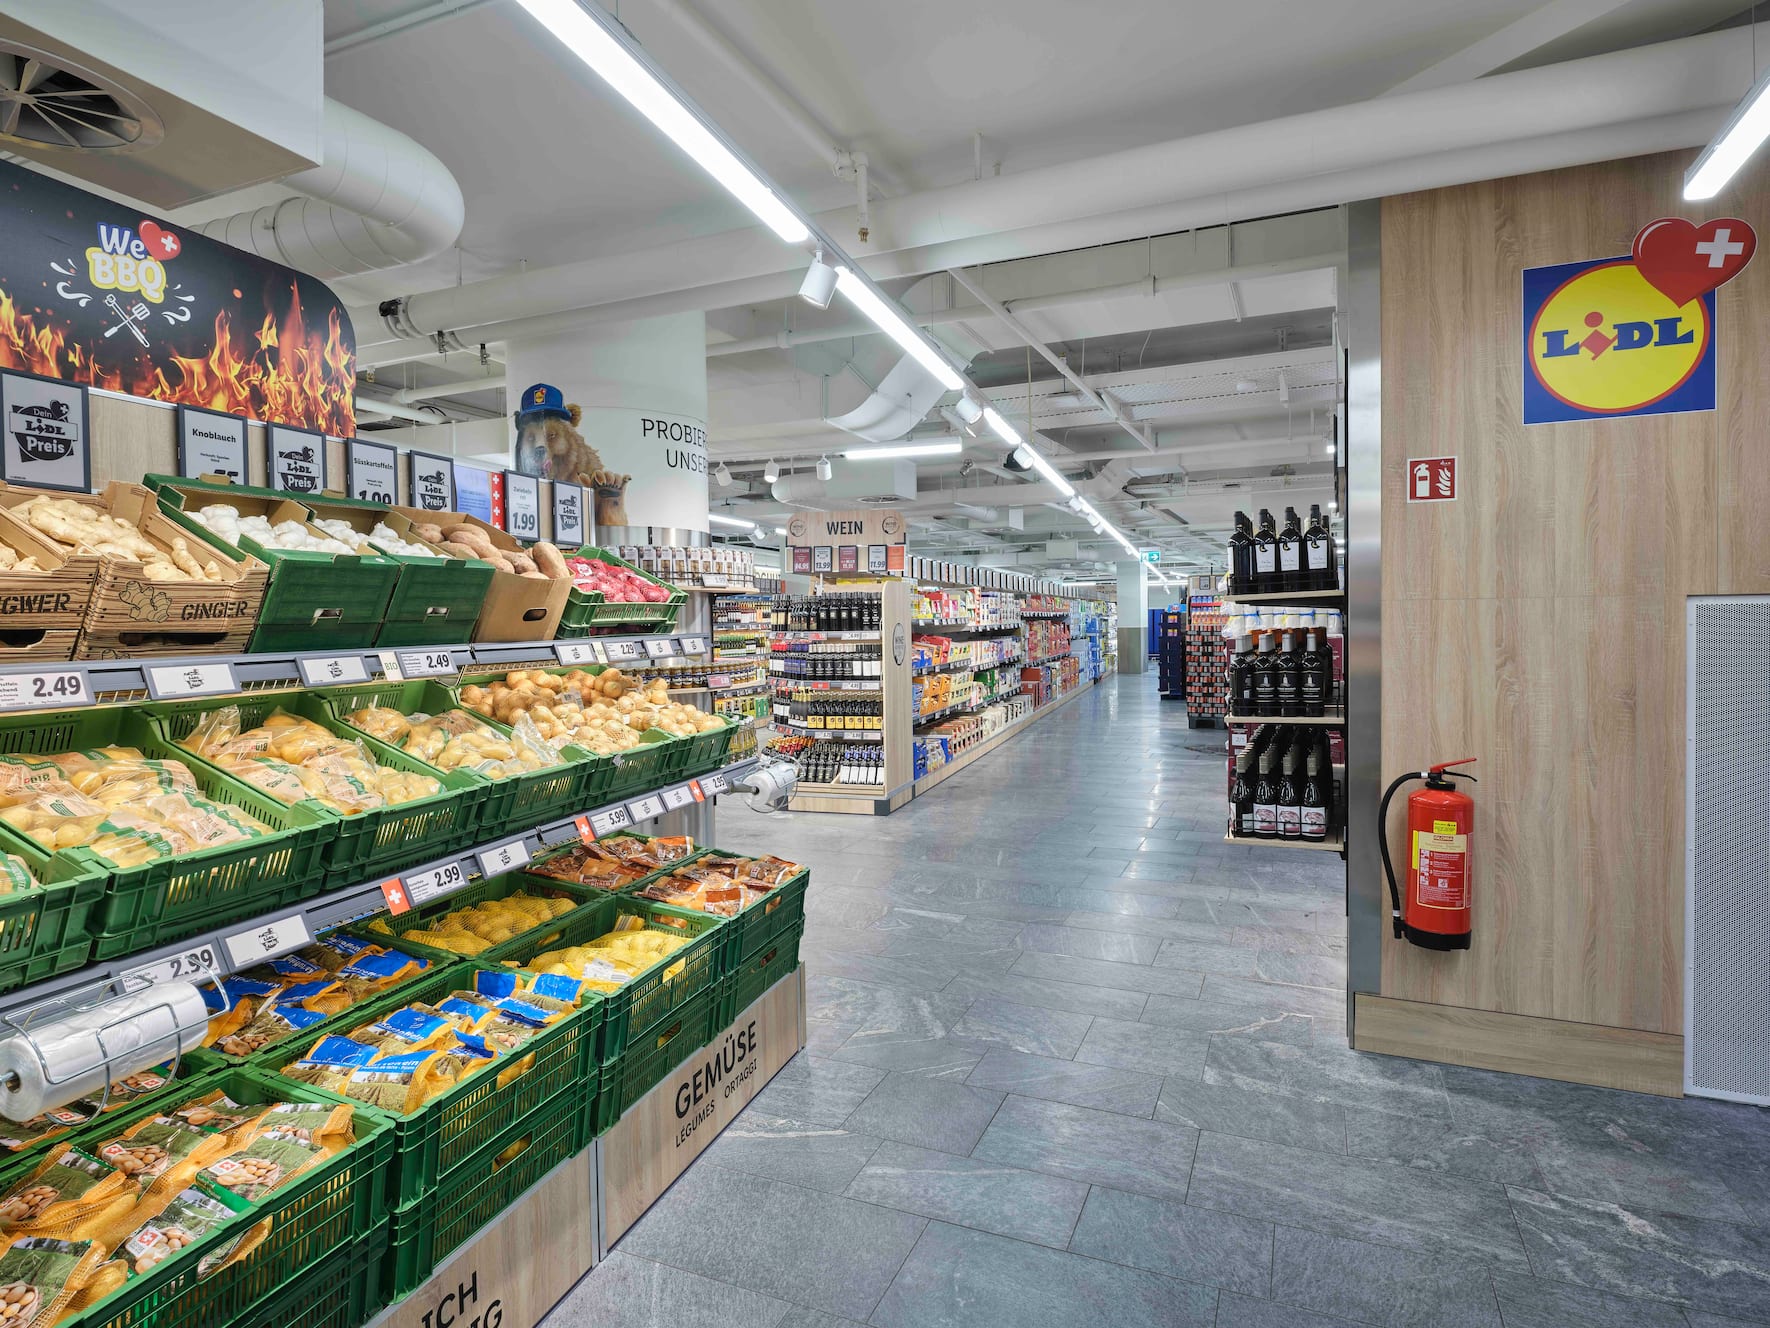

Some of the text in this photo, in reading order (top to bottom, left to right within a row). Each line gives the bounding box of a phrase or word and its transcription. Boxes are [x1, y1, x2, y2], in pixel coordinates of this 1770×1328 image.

[99, 223, 146, 258] We
[92, 256, 164, 300] BBQ
[1542, 311, 1694, 361] LIDL
[33, 407, 52, 418] Dein
[25, 418, 66, 435] LIDL
[192, 428, 237, 443] Knoblauch
[26, 436, 65, 453] Preis
[287, 461, 312, 474] LIDL
[287, 474, 312, 488] Preis
[512, 512, 535, 531] 1.99
[826, 520, 863, 535] WEIN
[0, 592, 71, 614] GWER
[181, 600, 248, 621] GINGER
[620, 642, 635, 655] 2.29
[384, 662, 399, 671] BIO
[426, 654, 449, 668] 2.49
[32, 675, 81, 697] 2.49
[609, 807, 626, 825] 5.99
[434, 866, 460, 887] 2.99
[675, 1020, 757, 1119] GEMÜSE
[676, 1058, 757, 1148] LÉGUMES ORTAGGI
